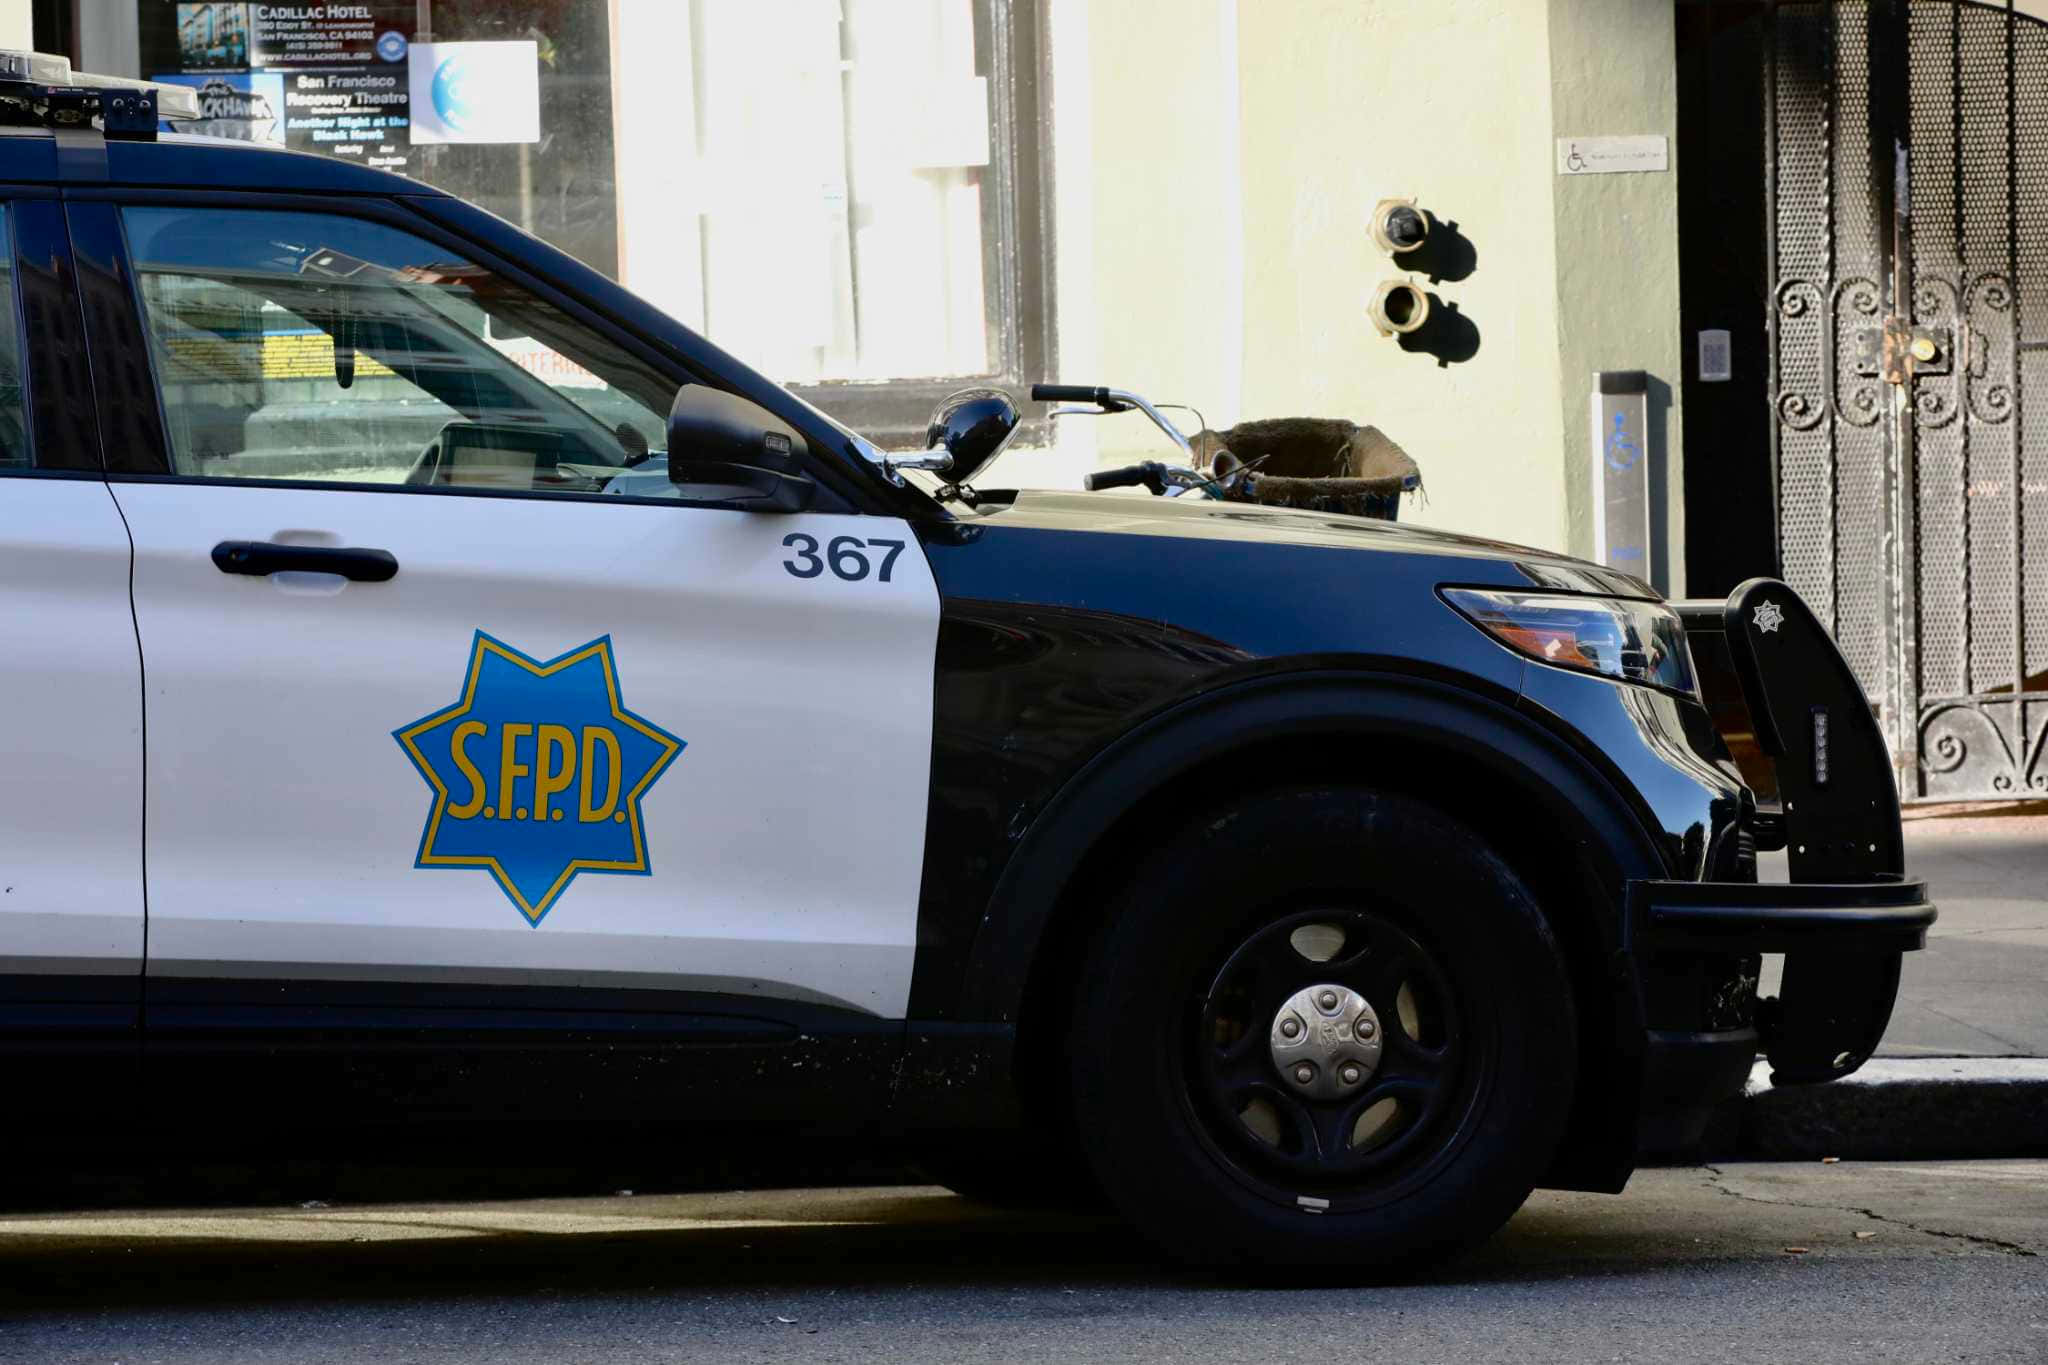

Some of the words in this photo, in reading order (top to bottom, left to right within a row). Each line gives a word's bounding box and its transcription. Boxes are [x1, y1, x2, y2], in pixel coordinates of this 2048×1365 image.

[257, 6, 324, 19] CADILLAC
[327, 5, 371, 18] HOTEL
[329, 31, 343, 40] CA
[297, 75, 325, 89] San
[327, 75, 396, 89] Francisco
[286, 92, 352, 108] Recovery
[354, 91, 408, 105] Theatre
[782, 532, 906, 583] 367
[446, 720, 627, 824] S.F.P.D.
